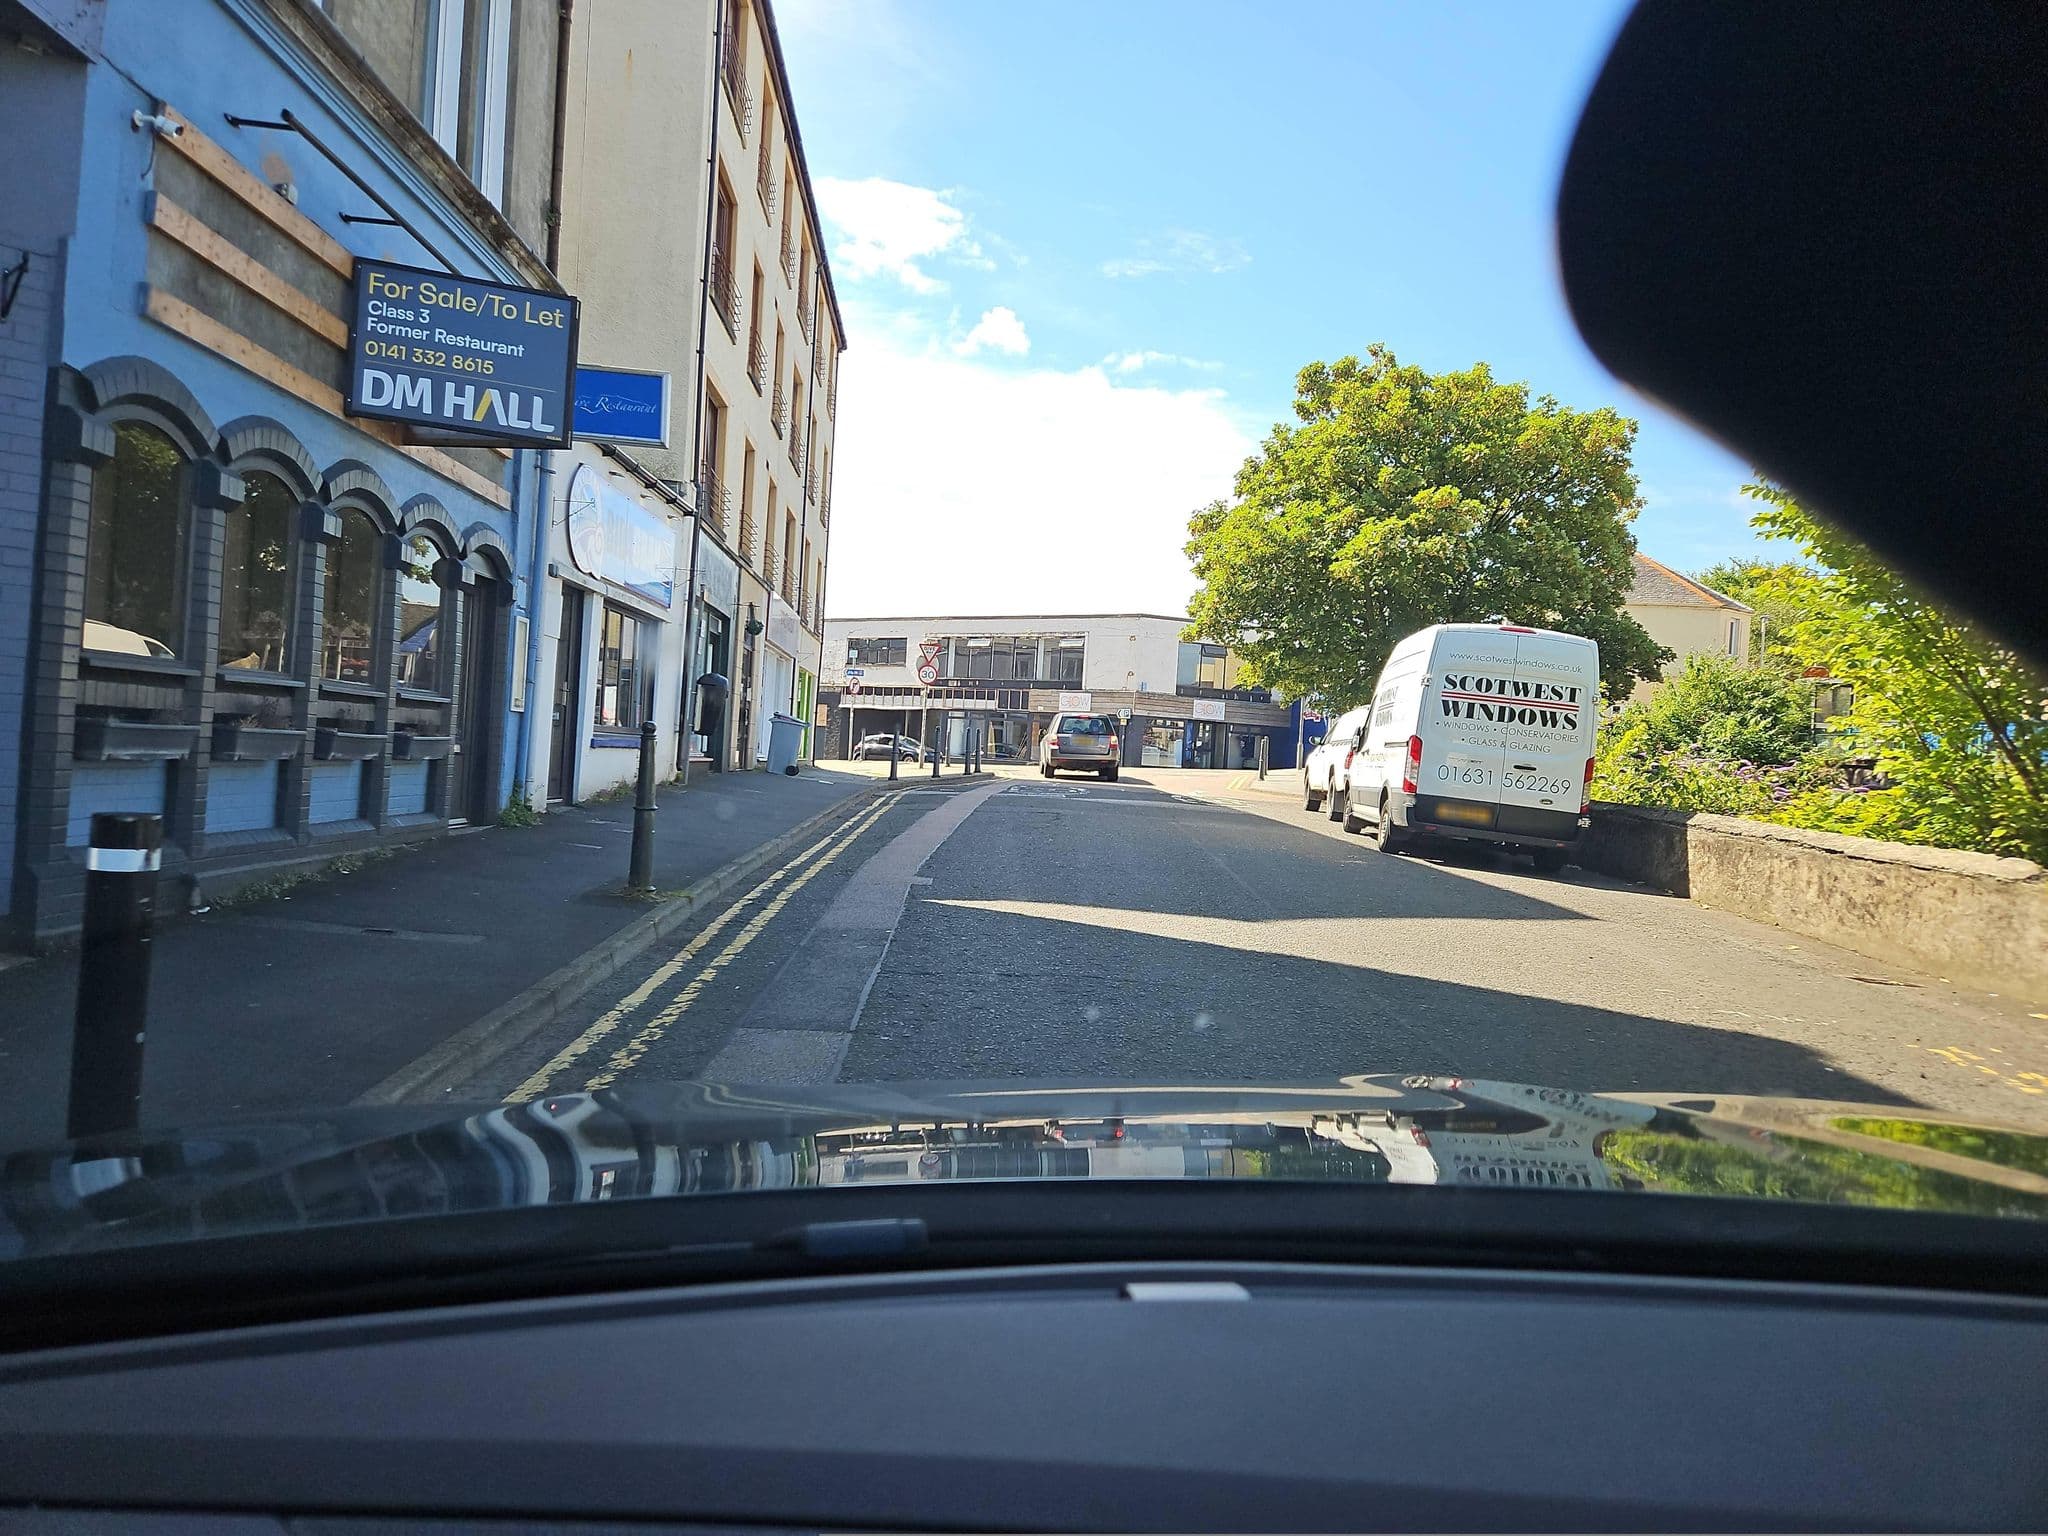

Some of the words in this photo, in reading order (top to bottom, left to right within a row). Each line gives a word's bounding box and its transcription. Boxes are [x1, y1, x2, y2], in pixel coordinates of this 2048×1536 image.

[367, 300, 415, 321] Class
[419, 308, 430, 324] 3
[368, 272, 413, 301] For
[419, 282, 517, 321] Sale/To
[525, 301, 565, 329] Let
[367, 318, 431, 341] Former
[435, 328, 525, 357] Restaurant
[365, 340, 407, 361] 0141
[412, 347, 446, 367] 332
[451, 354, 495, 375] 8615
[361, 368, 432, 415] DM
[443, 381, 555, 433] HALL
[921, 670, 934, 680] 30
[1449, 651, 1583, 674] www.scotwestwindows.co.uk
[1443, 673, 1582, 703] SCOTWEST
[1441, 699, 1579, 731] WINDOWS
[1443, 720, 1490, 733] WINDOWS
[1500, 727, 1579, 744] CONSERVATORIES
[1468, 736, 1497, 748] GLASS
[1499, 739, 1506, 748] &
[1509, 741, 1551, 754] GLAZING
[1437, 764, 1494, 786] 01631
[1502, 772, 1572, 795] 562269
